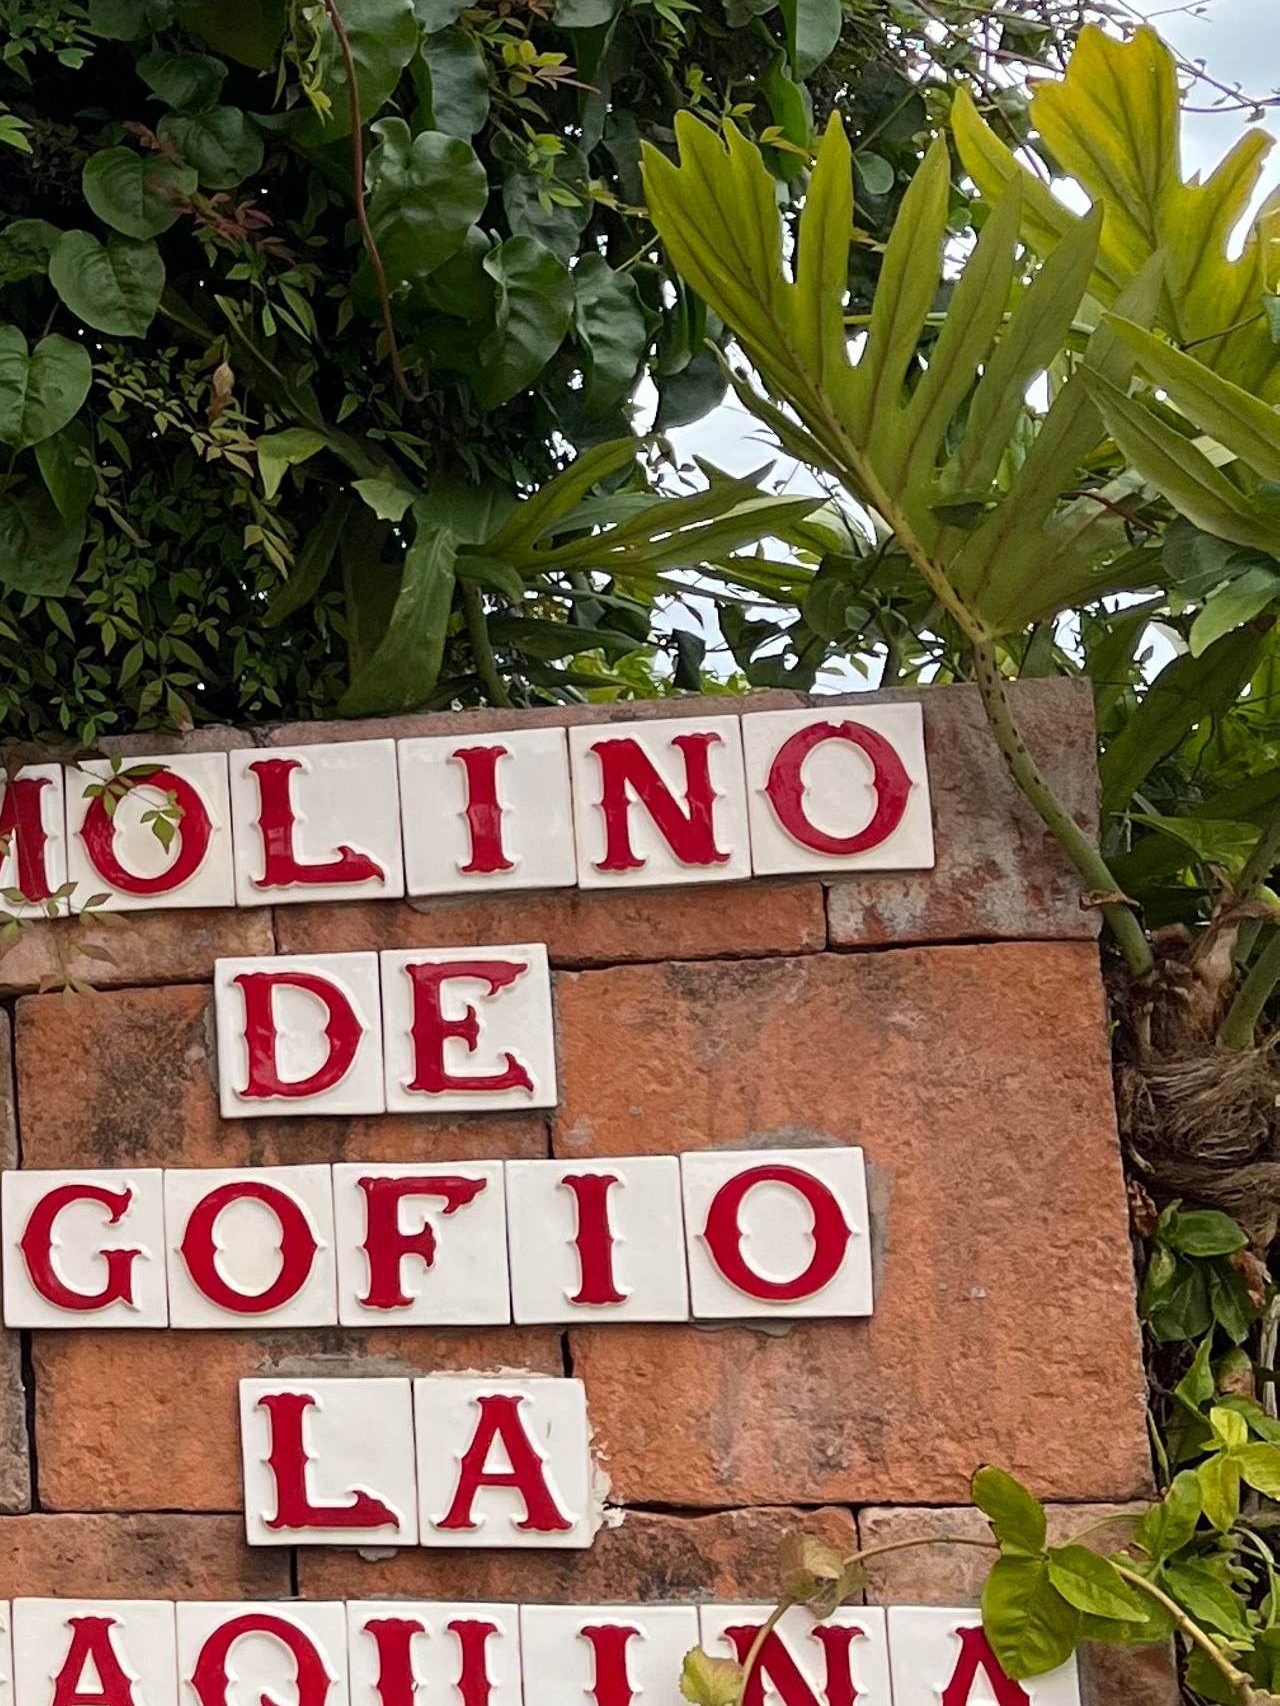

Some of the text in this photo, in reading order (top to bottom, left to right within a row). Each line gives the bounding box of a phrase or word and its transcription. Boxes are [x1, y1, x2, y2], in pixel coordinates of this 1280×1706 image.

[232, 960, 535, 1100] DE
[19, 1164, 853, 1314] GOFIO
[256, 1392, 571, 1533] LA
